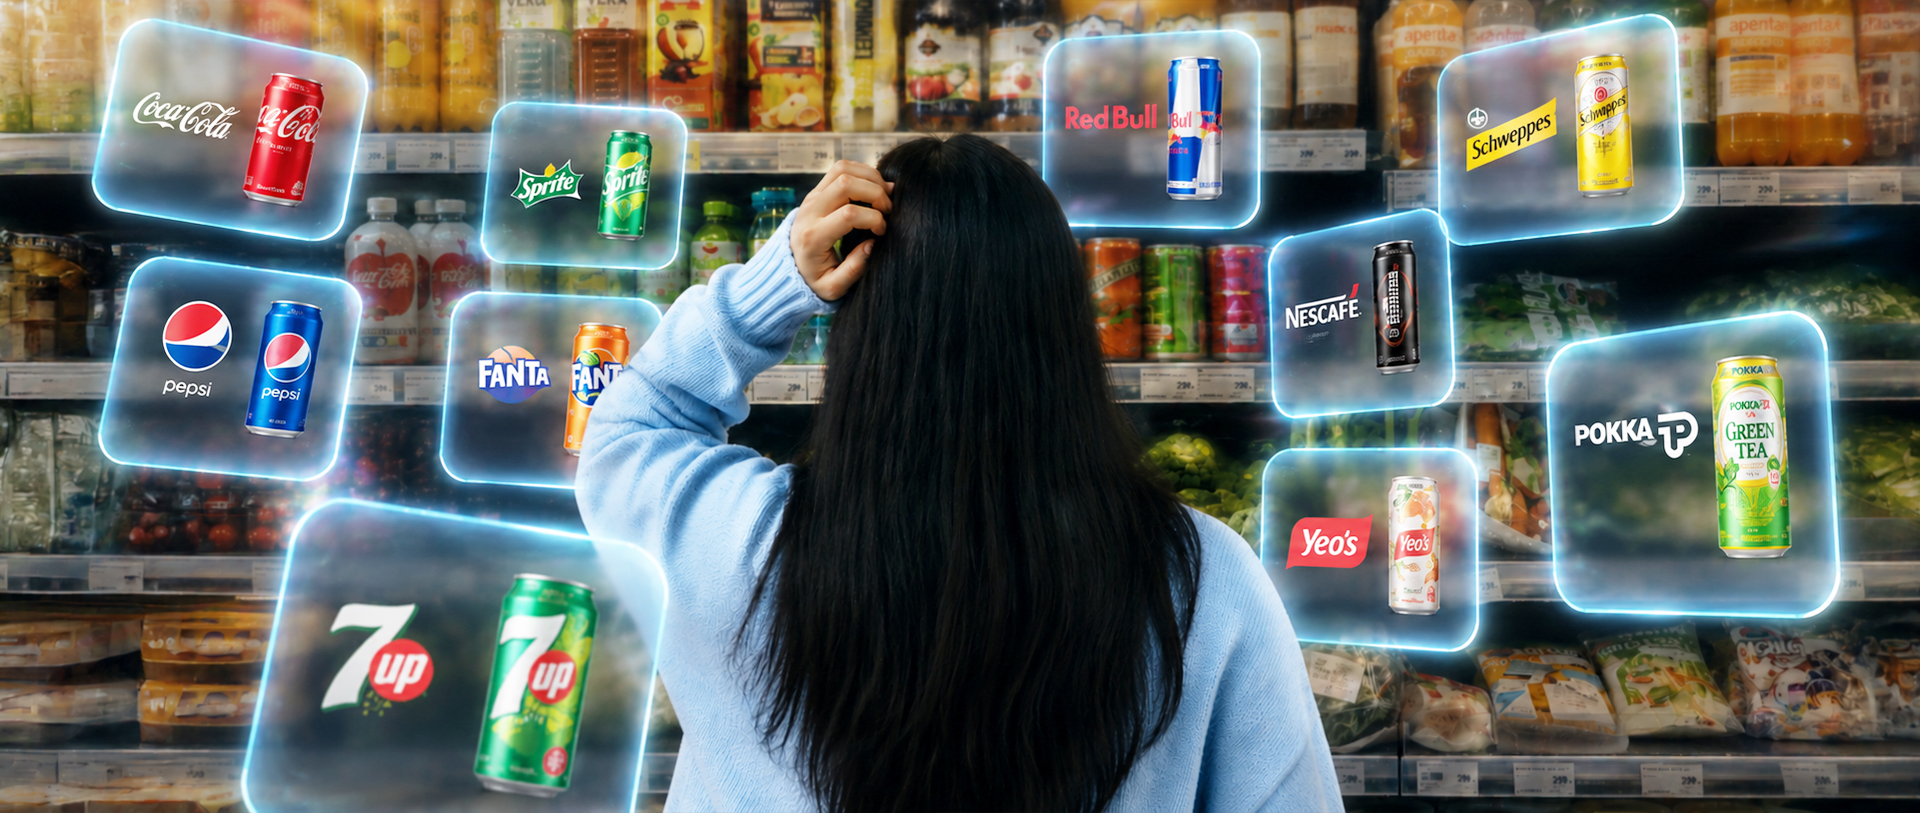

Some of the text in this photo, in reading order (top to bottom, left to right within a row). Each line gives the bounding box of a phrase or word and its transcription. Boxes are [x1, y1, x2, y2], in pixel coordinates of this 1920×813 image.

[602, 165, 649, 202] Sprite
[571, 363, 624, 391] FANT
[261, 386, 302, 402] pepsi
[1725, 422, 1775, 441] GREEN
[1735, 442, 1769, 459] TEA
[1400, 533, 1430, 552] Yeo's
